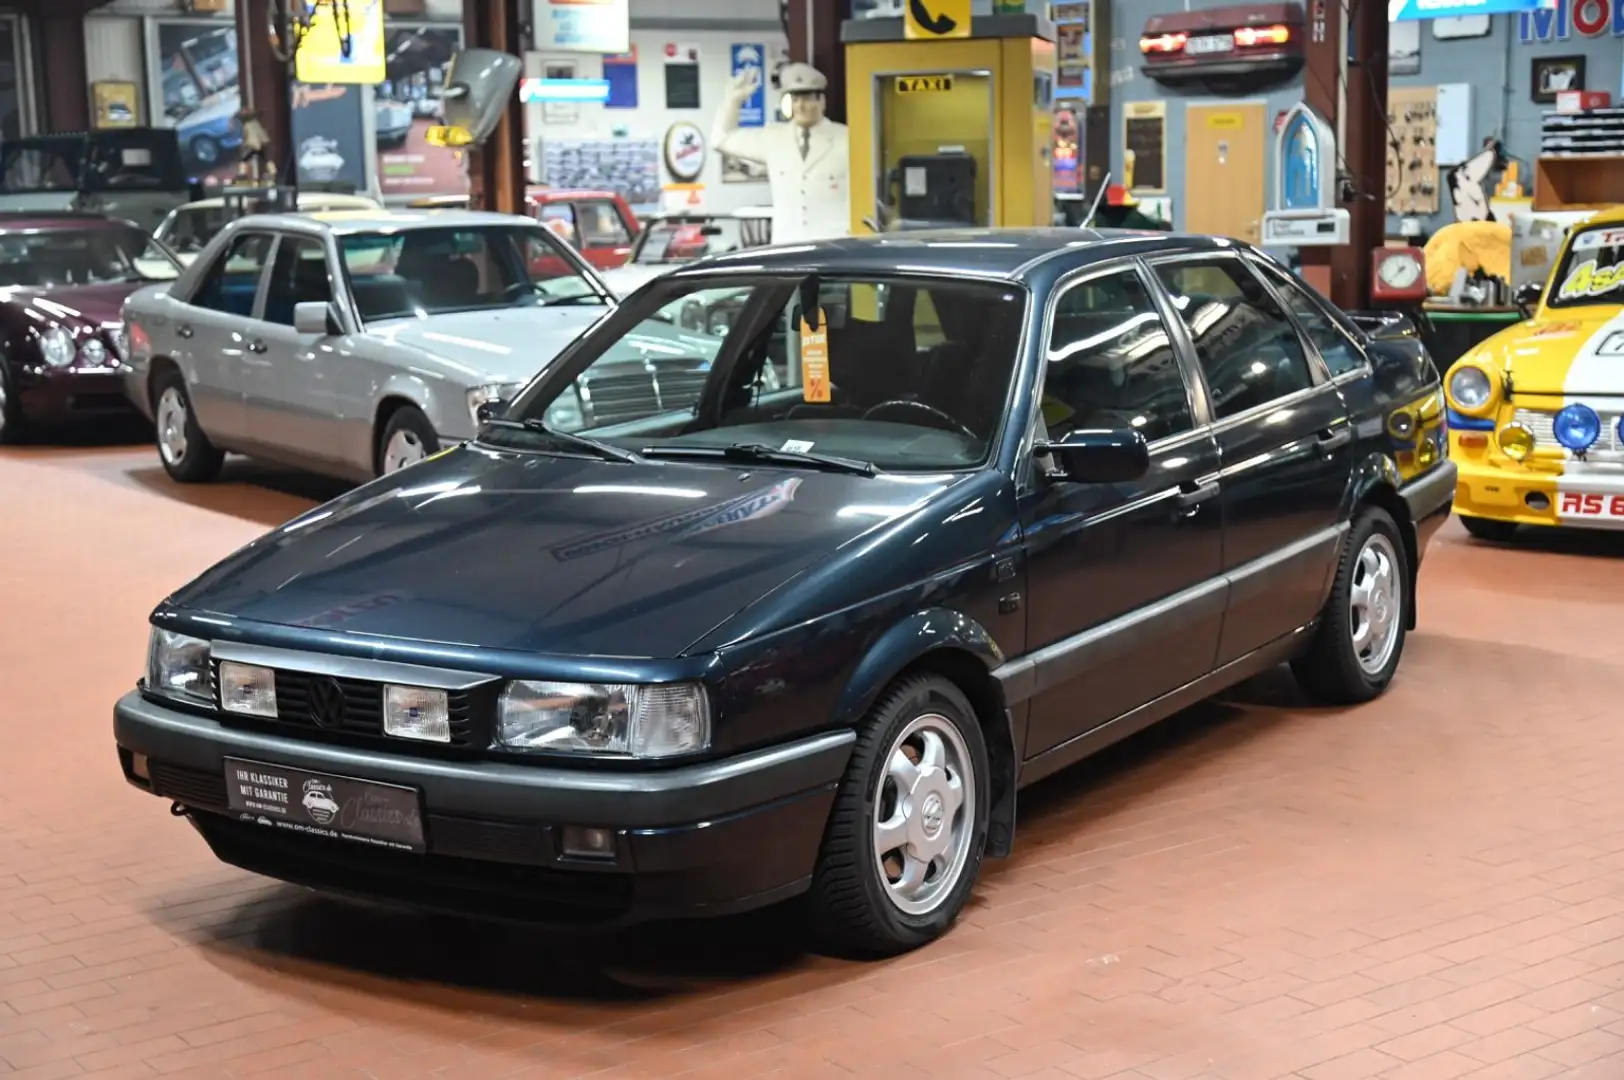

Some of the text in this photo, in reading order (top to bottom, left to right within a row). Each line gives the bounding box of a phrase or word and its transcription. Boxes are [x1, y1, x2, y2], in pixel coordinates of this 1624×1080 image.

[899, 78, 947, 91] TAXI
[236, 769, 289, 789] IHR KLASSIKER
[240, 784, 289, 804] MIT GARANTIE
